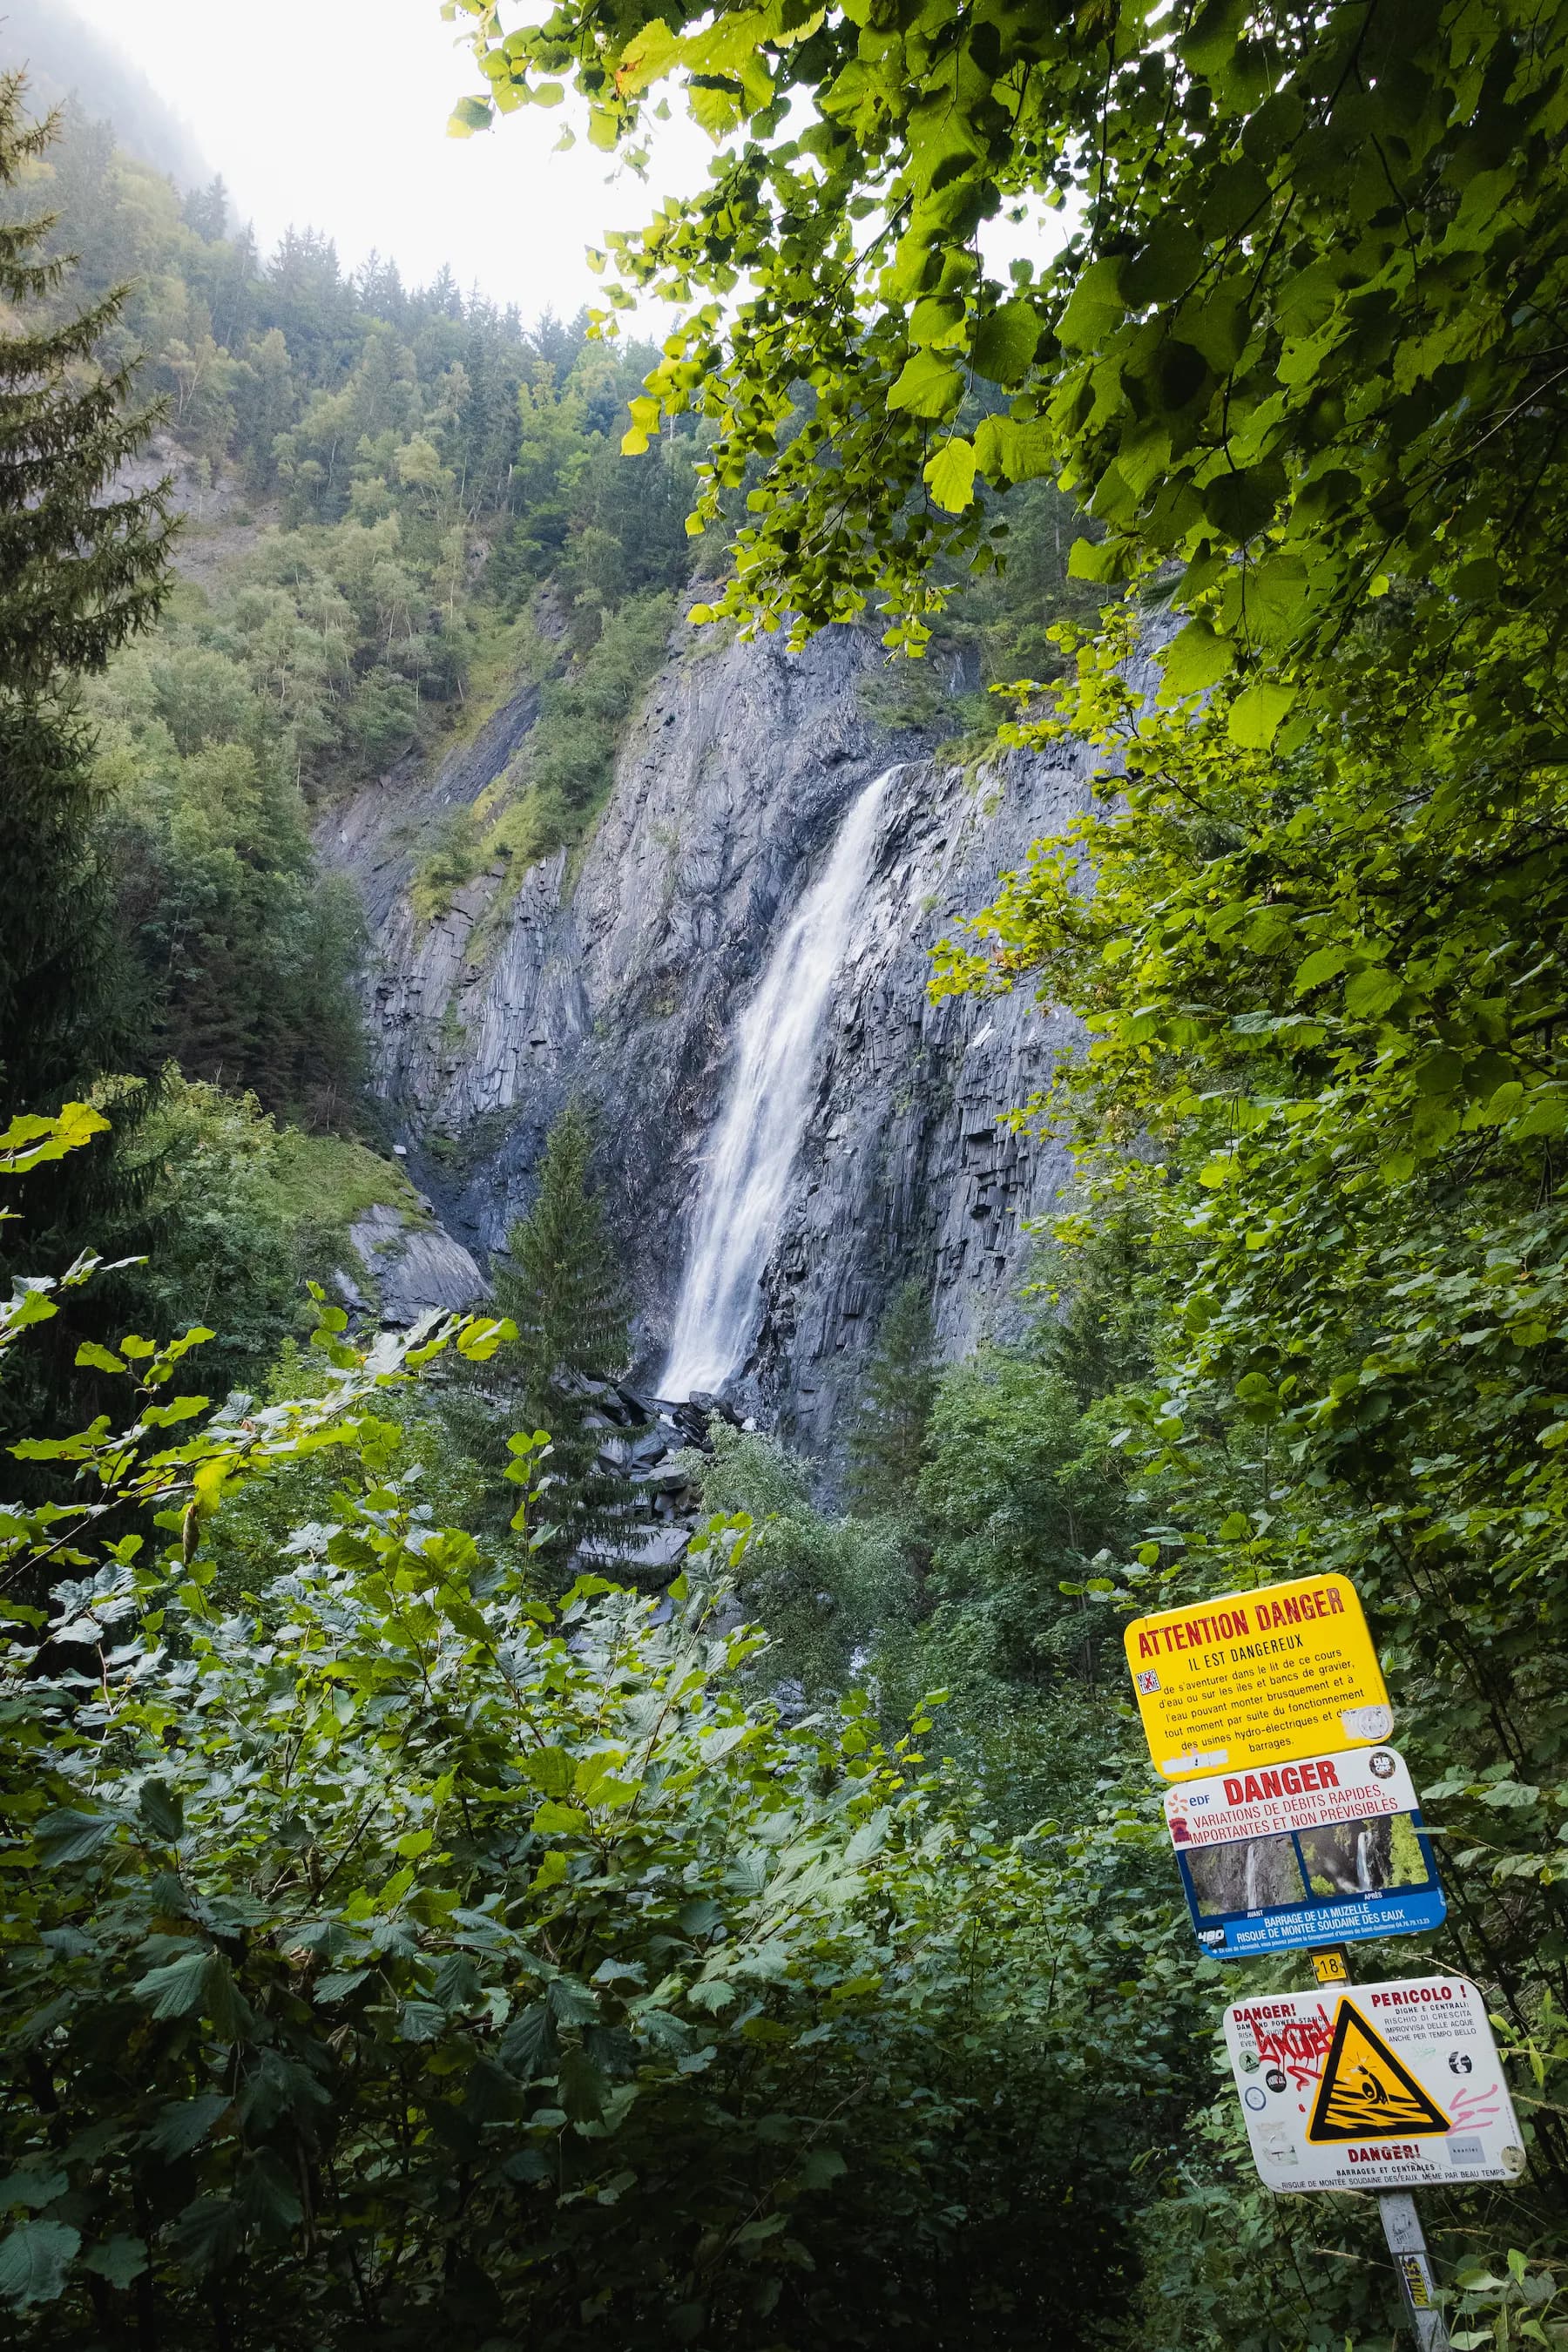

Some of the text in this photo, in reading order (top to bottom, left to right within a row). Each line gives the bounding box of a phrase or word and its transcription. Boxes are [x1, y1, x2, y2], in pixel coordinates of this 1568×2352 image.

[1139, 1587, 1345, 1659] ATTENTION DANGER
[1188, 1633, 1303, 1672] IL EST DANGEREUX
[1159, 1699, 1183, 1709] d'eau
[1186, 1694, 1199, 1703] ou
[1201, 1691, 1215, 1700] sur
[1220, 1687, 1233, 1697] les
[1256, 1679, 1267, 1688] et
[1269, 1673, 1299, 1686] bancs
[1302, 1668, 1315, 1678] de
[1319, 1659, 1355, 1675] gravier,
[1163, 1649, 1342, 1695] de s'aventurer dans le lit de ce cours
[1166, 1713, 1188, 1723] l'eau
[1191, 1703, 1227, 1719] pouvant
[1231, 1695, 1263, 1709] monter
[1267, 1680, 1329, 1701] brusquement
[1334, 1677, 1344, 1687] et
[1165, 1688, 1365, 1738] tout moment par suite du fonctionnement
[1181, 1740, 1199, 1751] des
[1201, 1734, 1232, 1747] usines
[1322, 1711, 1333, 1721] et
[1249, 1738, 1294, 1752] barrages.
[1223, 1761, 1341, 1806] DANGER
[1193, 1784, 1386, 1828] VARIATIONS DE DÉBITS RAPIDES,
[1189, 1820, 1270, 1845] IMPORTANTES
[1274, 1817, 1287, 1830] ET
[1291, 1812, 1317, 1828] NON
[1320, 1797, 1398, 1823] PRÉVISIBLES
[1237, 1930, 1267, 1943] RISQUE
[1268, 1928, 1281, 1938] DE
[1317, 1916, 1361, 1931] SOUDAINE
[1362, 1913, 1380, 1924] DES
[1381, 1909, 1405, 1923] EAUX
[1264, 1903, 1370, 1929] BARRAGE DE LA MUZELLE
[1320, 1958, 1339, 1975] 18
[1371, 1986, 1452, 2008] PERICOLO
[1233, 2004, 1297, 2022] DANGER!
[1272, 2018, 1295, 2027] POWER
[1384, 2015, 1417, 2025] RISCHIO
[1432, 2010, 1472, 2020] CRESCITA
[1396, 2006, 1418, 2015] DIGHE
[1385, 2018, 1475, 2034] IMPROVVISA DELLE ACQUE
[1413, 2032, 1427, 2041] PER
[1429, 2031, 1452, 2039] TEMPO
[1455, 2027, 1477, 2037] BELLO
[1348, 2144, 1421, 2163] DANGER!
[1281, 2180, 1306, 2189] RISQUE
[1348, 2176, 1382, 2186] SOUDAINE
[1384, 2174, 1398, 2183] DES
[1460, 2170, 1479, 2179] BEAU
[1481, 2168, 1506, 2177] TEMPS
[1336, 2167, 1376, 2176] BARRAGES
[1391, 2163, 1436, 2173] CENTRALES
